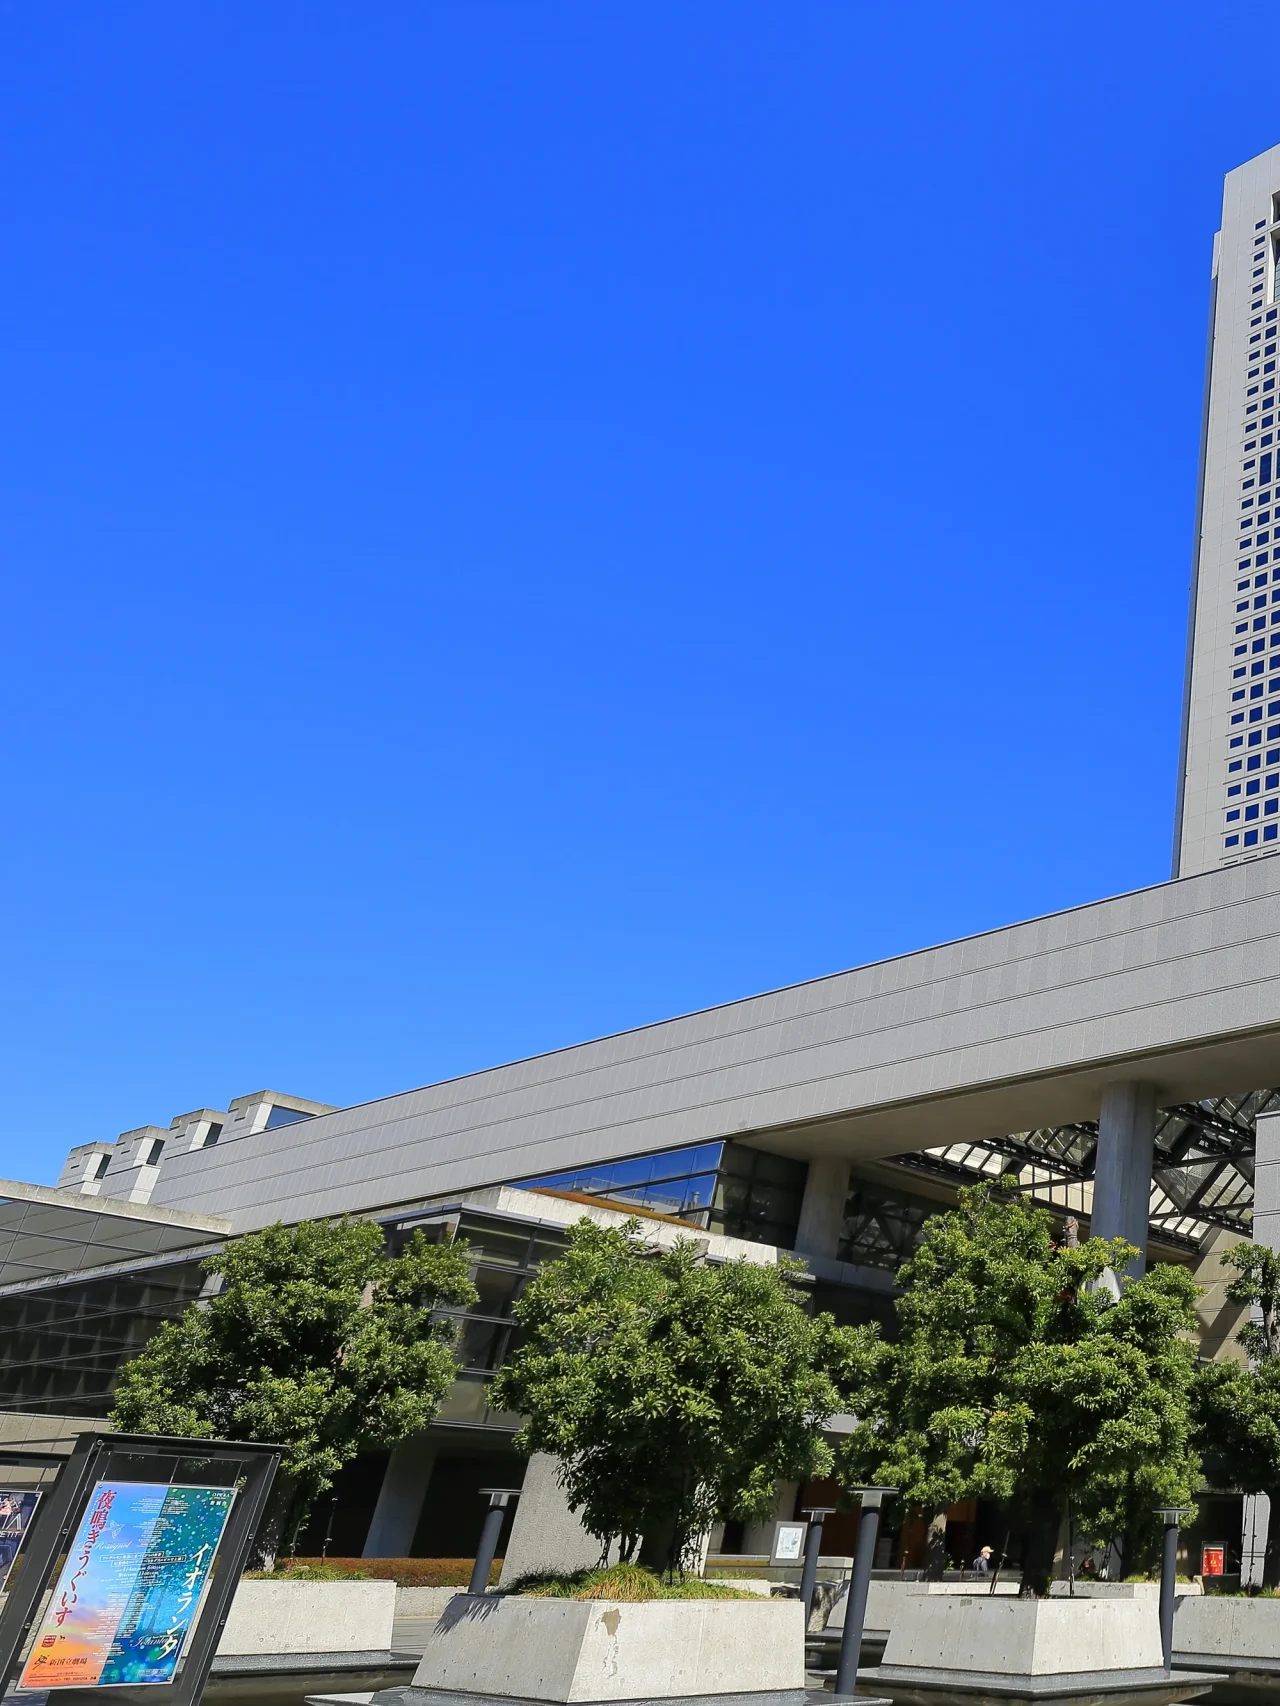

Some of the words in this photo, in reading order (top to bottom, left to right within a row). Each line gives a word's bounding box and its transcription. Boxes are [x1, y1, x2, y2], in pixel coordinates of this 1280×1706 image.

[55, 1490, 117, 1628] 夜鳴きうぐいす
[157, 1543, 209, 1660] イオランタ
